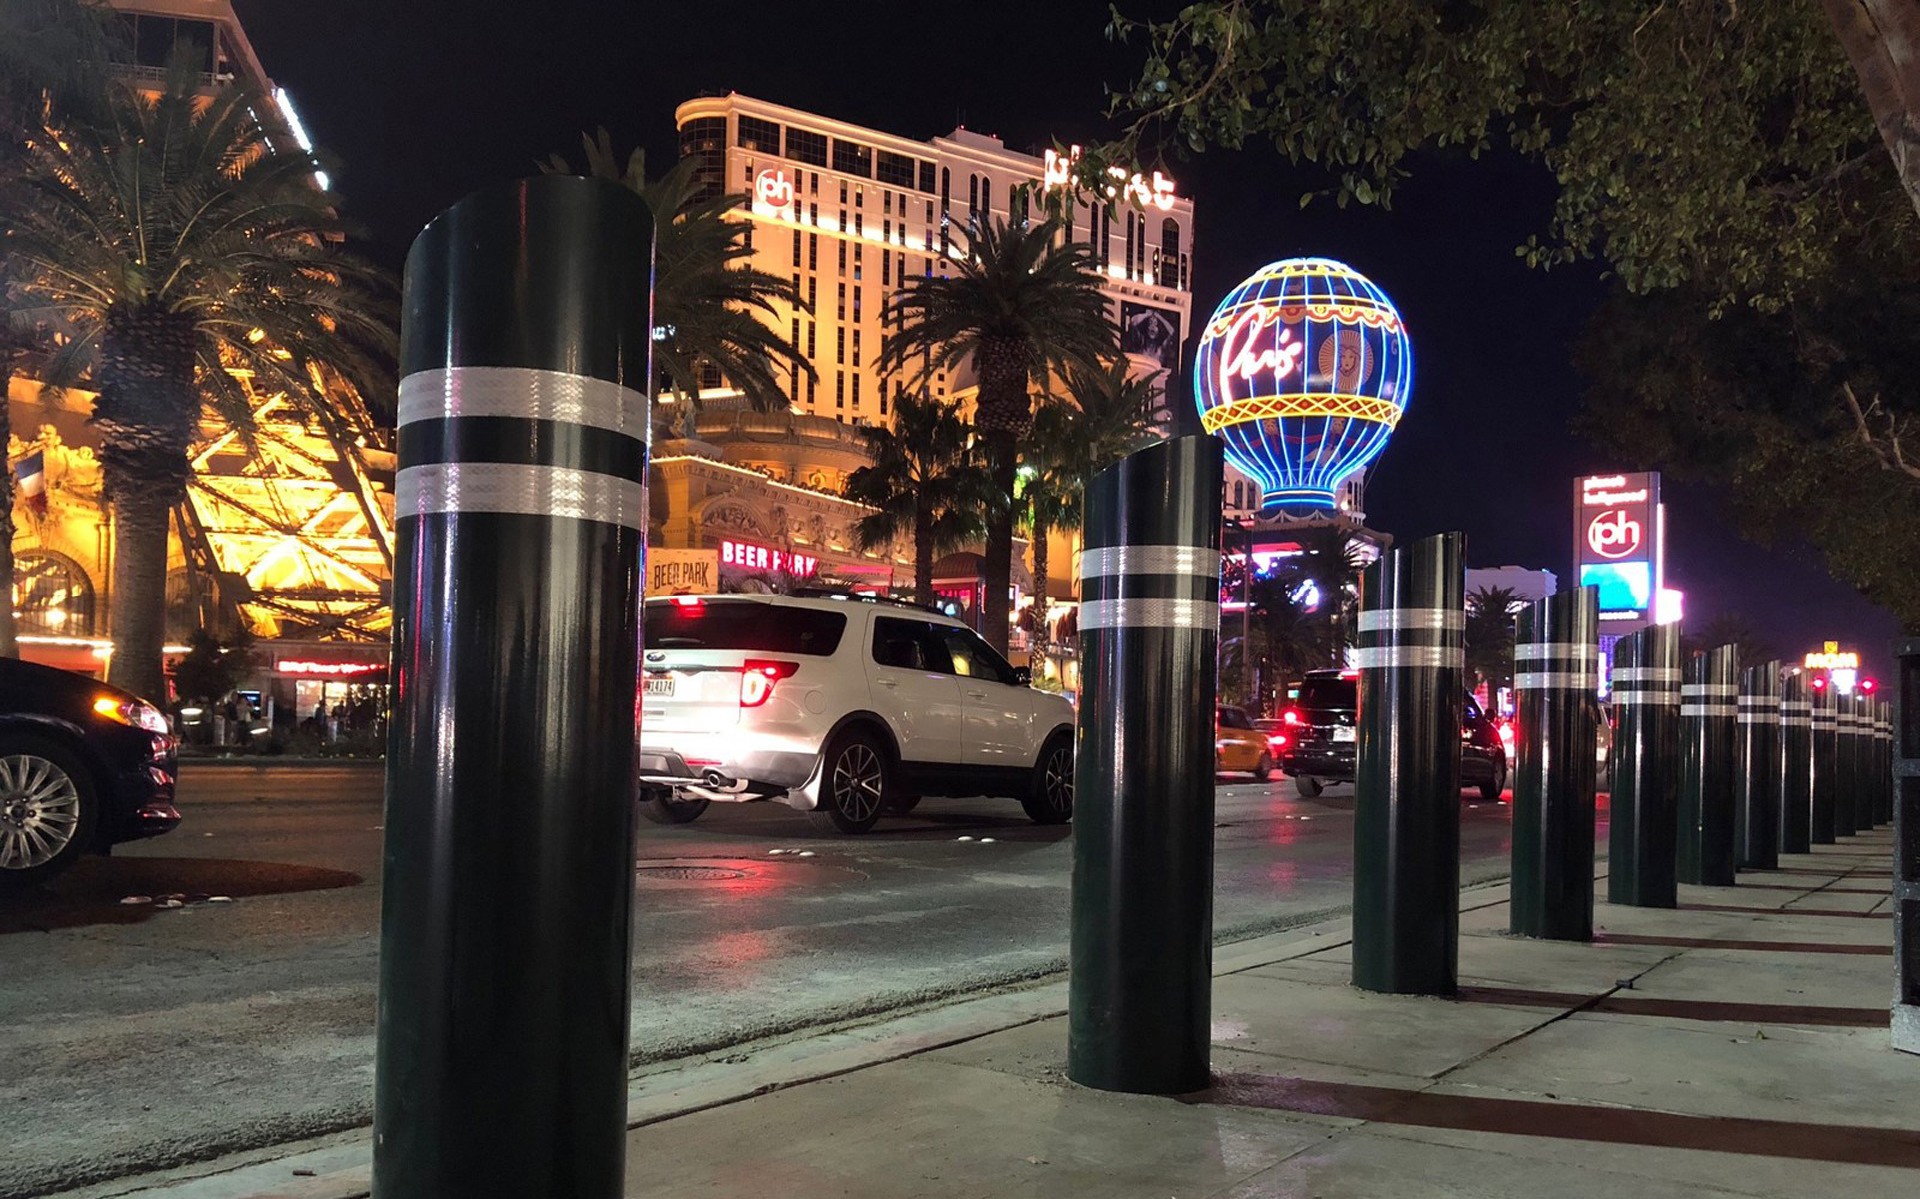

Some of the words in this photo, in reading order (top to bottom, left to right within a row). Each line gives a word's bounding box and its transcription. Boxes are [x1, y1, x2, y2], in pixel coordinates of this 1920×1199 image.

[757, 170, 793, 206] ph
[1219, 303, 1304, 409] Paris
[1588, 510, 1640, 557] ph
[722, 541, 768, 568] BEER
[654, 562, 680, 590] BEER
[682, 561, 709, 588] PARK
